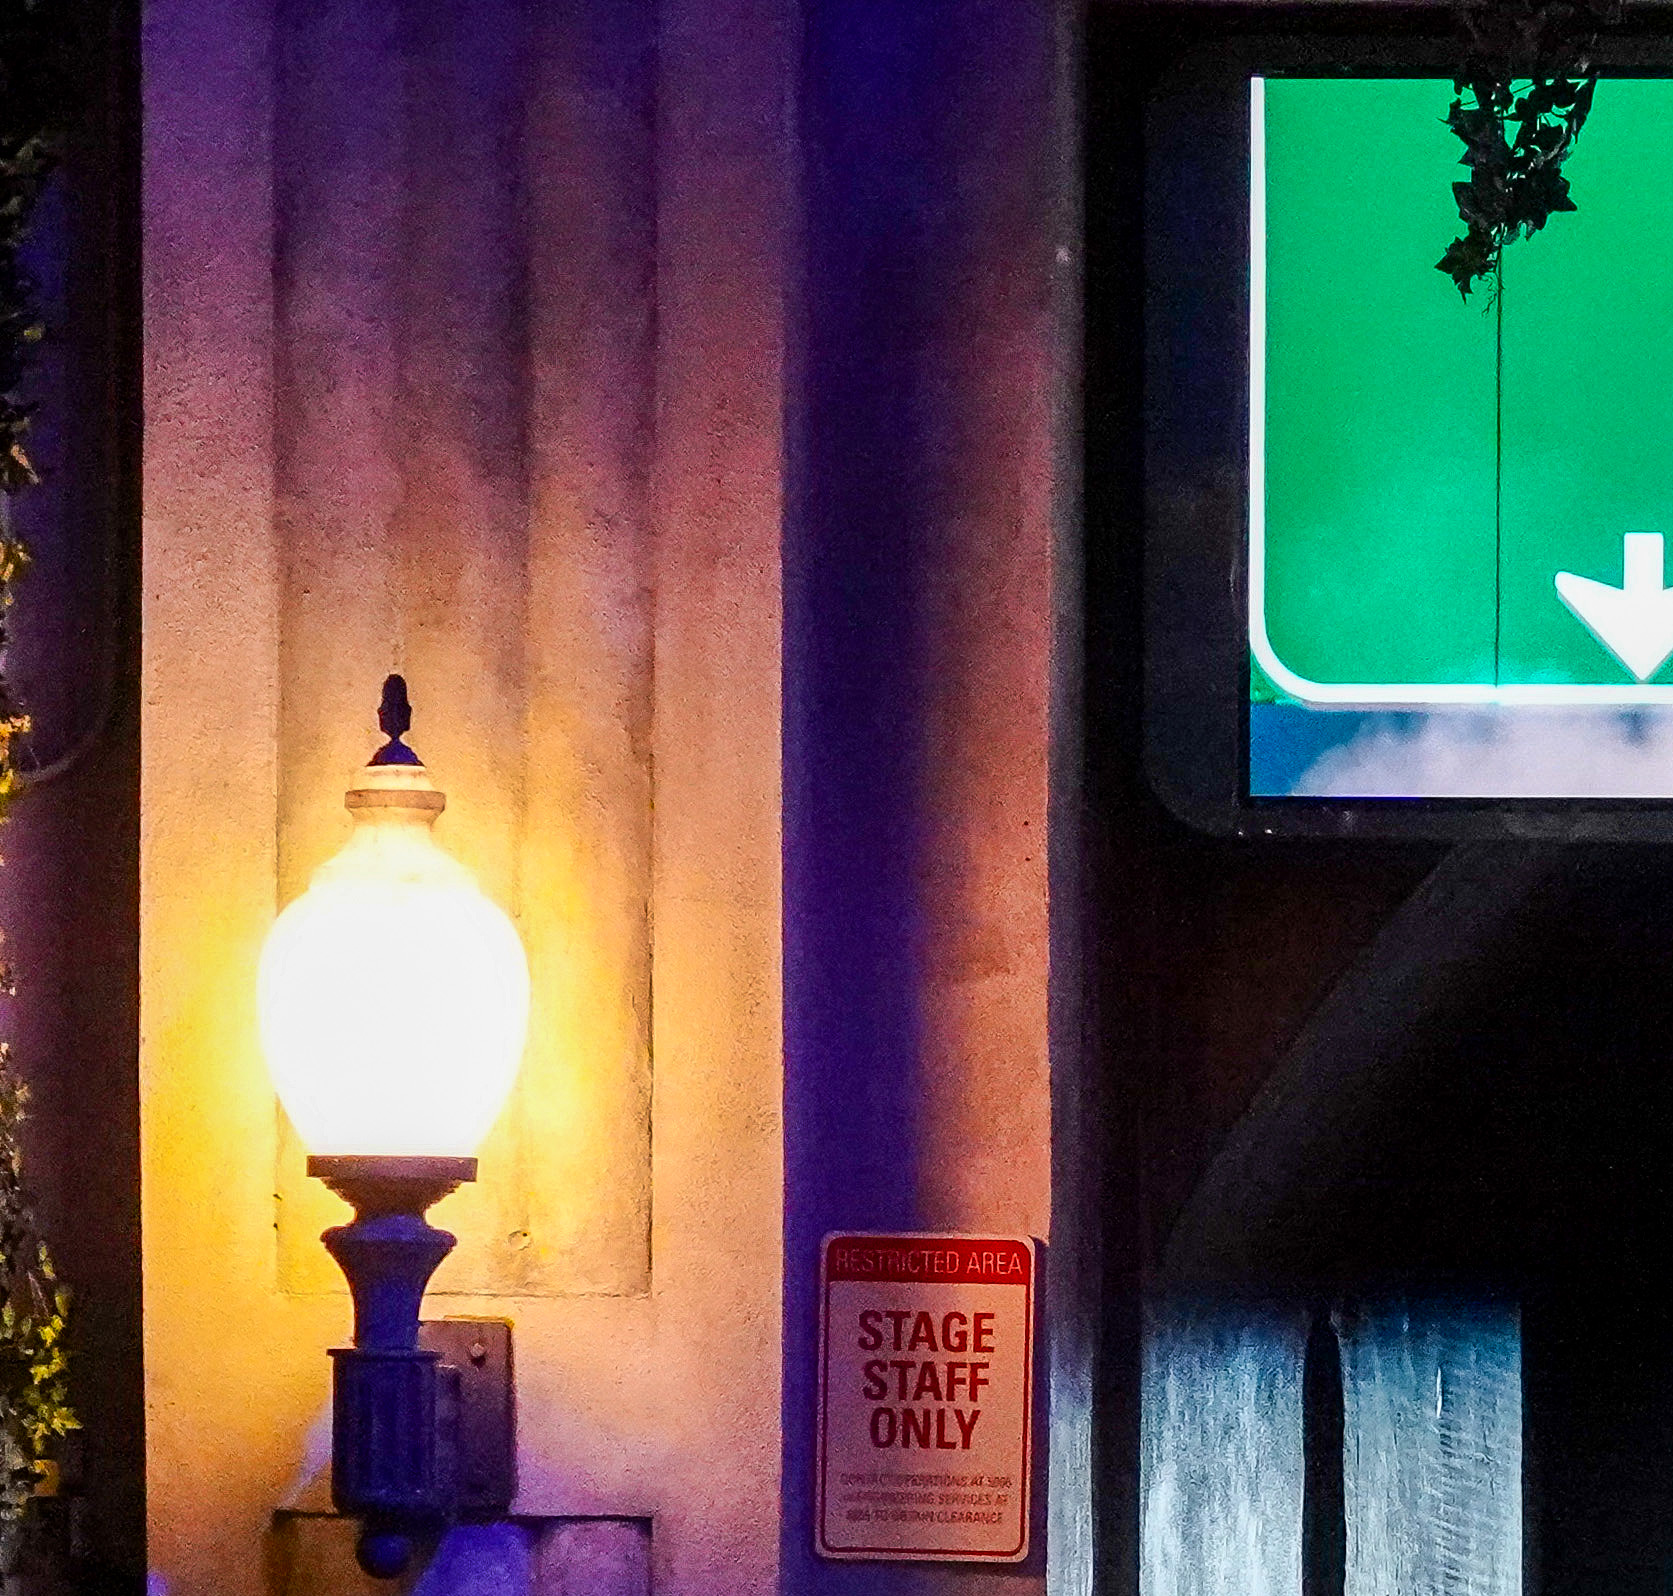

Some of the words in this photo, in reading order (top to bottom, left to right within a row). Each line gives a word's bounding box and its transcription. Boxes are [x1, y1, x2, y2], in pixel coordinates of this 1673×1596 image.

[836, 1248, 960, 1274] RESTRICTED
[967, 1251, 1023, 1275] AREA
[858, 1309, 995, 1353] STAGE
[862, 1360, 990, 1402] STAFF
[869, 1406, 981, 1451] ONLY
